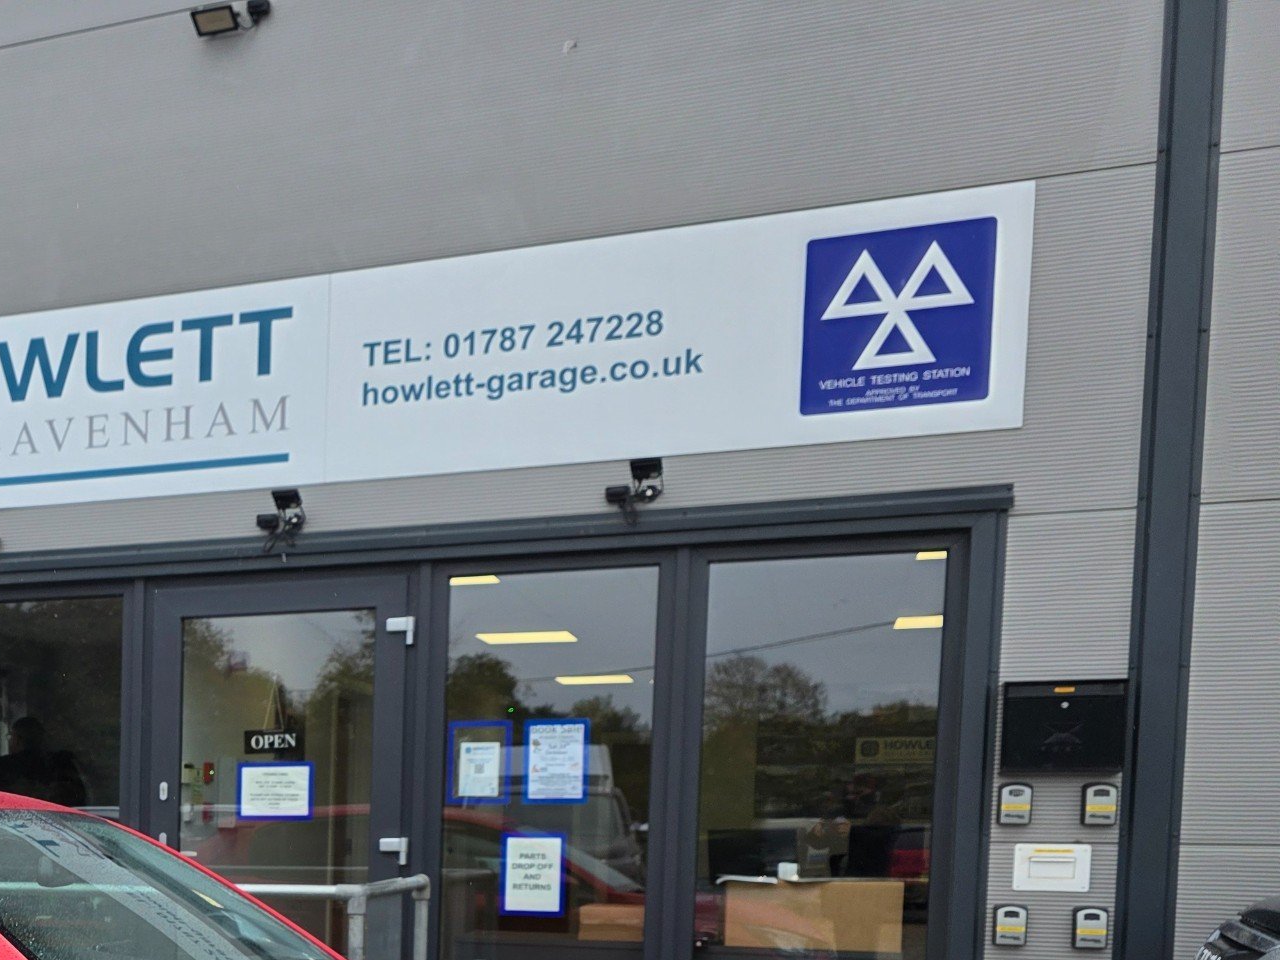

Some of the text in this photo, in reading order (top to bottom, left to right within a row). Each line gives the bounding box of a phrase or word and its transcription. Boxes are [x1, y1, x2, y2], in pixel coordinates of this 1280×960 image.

[362, 309, 665, 368] TEL: 01787 247228
[361, 348, 705, 407] howlett-garage.co.uk
[818, 366, 971, 391] VEHICLE TESTING STATION
[827, 399, 843, 408] THE
[896, 393, 909, 401] OF
[250, 732, 297, 750] OPEN
[519, 852, 547, 860] PARTS
[511, 862, 554, 870] DROP OFF
[512, 883, 553, 891] RETURNS
